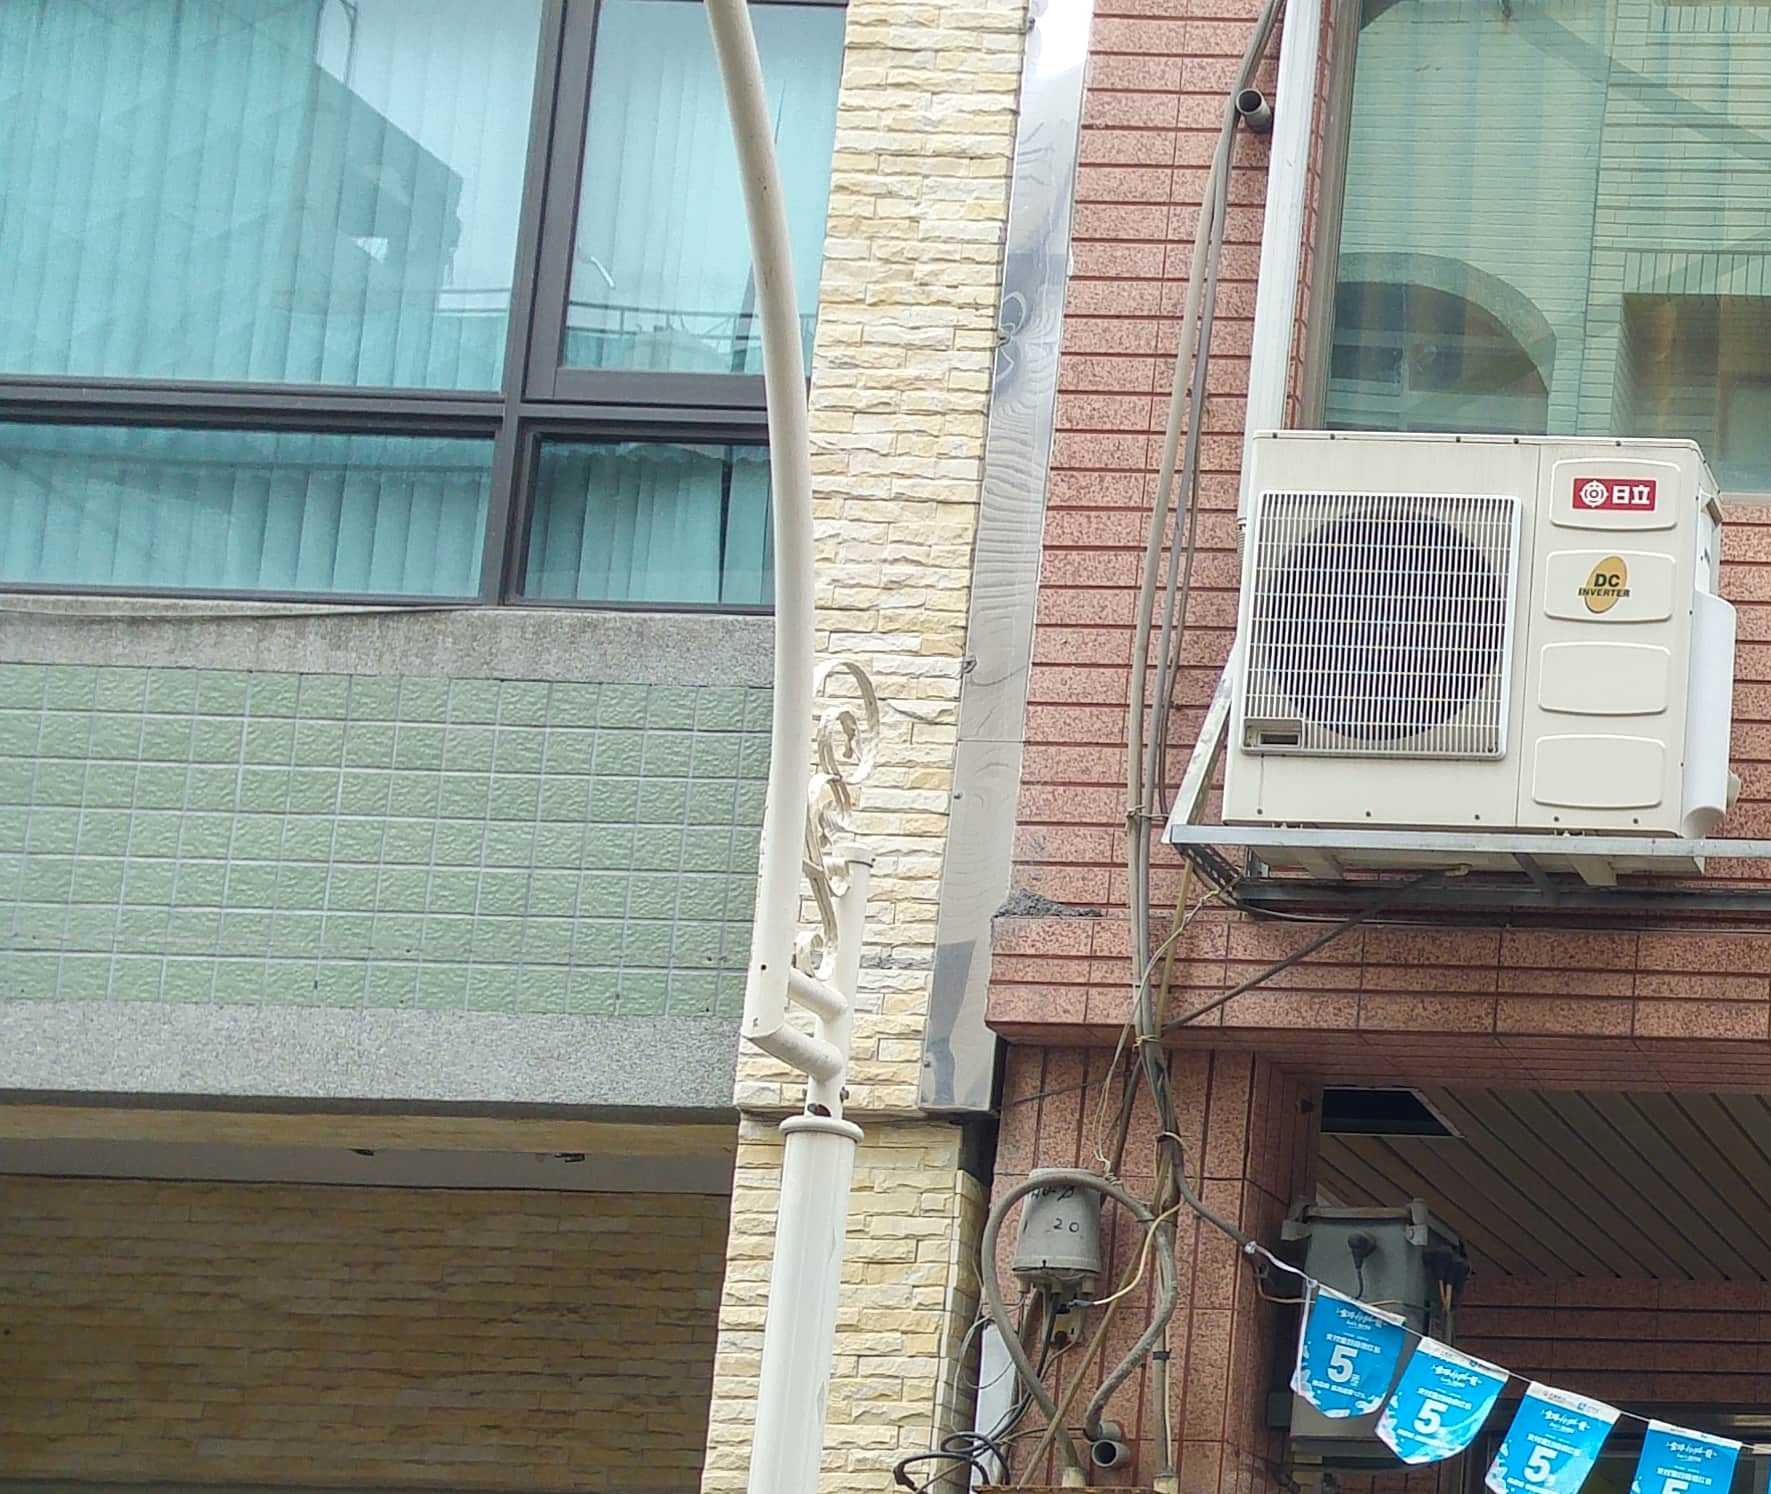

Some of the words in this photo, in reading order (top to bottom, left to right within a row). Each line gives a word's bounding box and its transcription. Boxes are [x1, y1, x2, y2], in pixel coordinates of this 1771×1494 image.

[1612, 483, 1651, 508] 日立
[1594, 573, 1621, 589] DC
[1578, 587, 1631, 600] INVERTER
